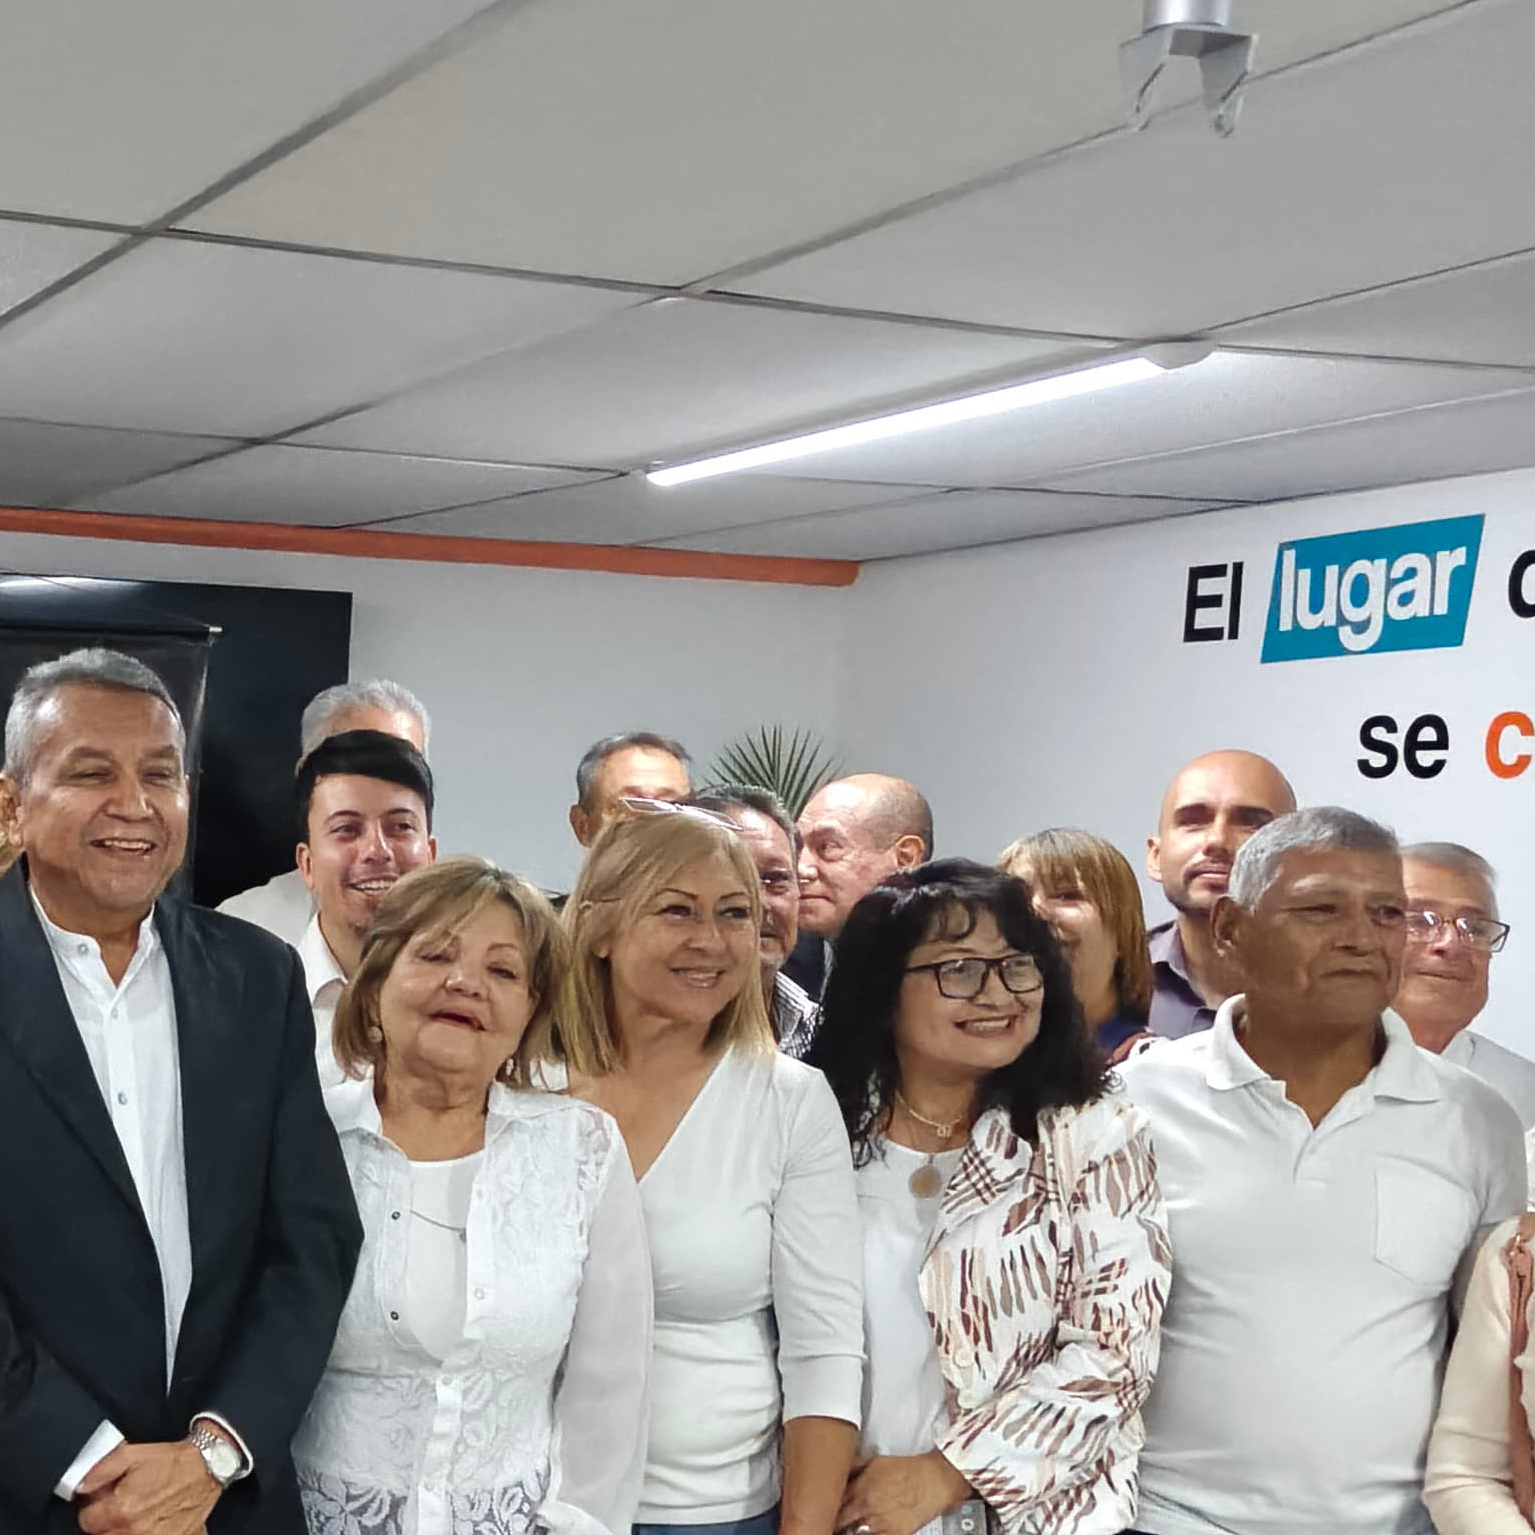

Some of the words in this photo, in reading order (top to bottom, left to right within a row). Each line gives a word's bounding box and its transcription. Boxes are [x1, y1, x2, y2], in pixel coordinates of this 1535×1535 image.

[1183, 561, 1244, 643] El
[1278, 546, 1467, 653] lugar
[1357, 714, 1450, 779] se
